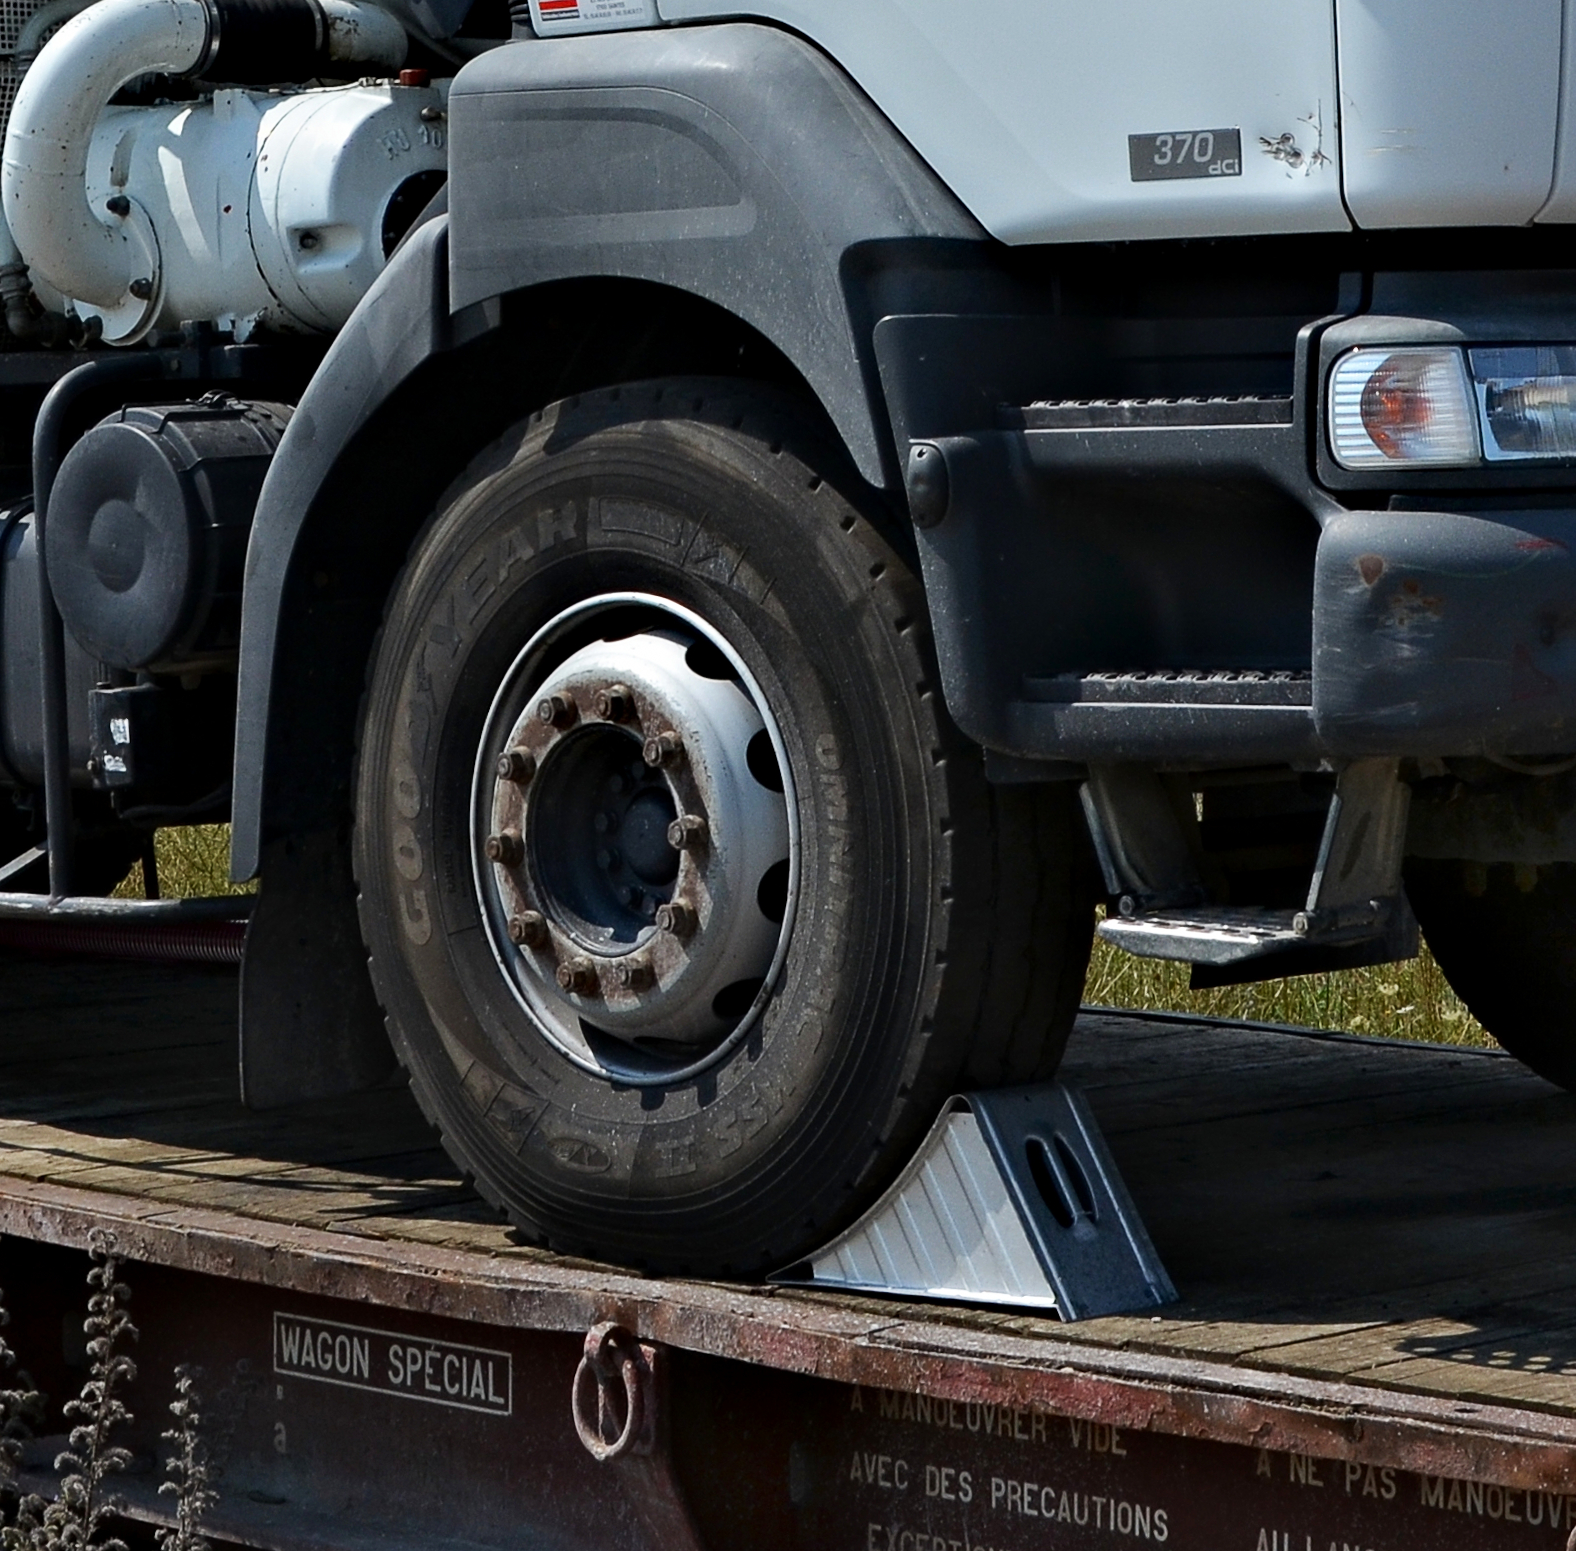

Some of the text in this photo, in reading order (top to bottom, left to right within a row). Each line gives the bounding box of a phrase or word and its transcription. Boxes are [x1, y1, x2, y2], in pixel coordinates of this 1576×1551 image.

[1154, 132, 1214, 165] 370
[1208, 159, 1239, 174] dCi
[280, 1324, 370, 1379] WAGON
[850, 1384, 1127, 1456] A MANOEUVRER VIDE
[850, 1451, 1168, 1541] AVEC DES PRECAUTIONS
[1256, 1449, 1272, 1478] A
[1289, 1454, 1324, 1487] NE
[1345, 1462, 1397, 1500] PAS
